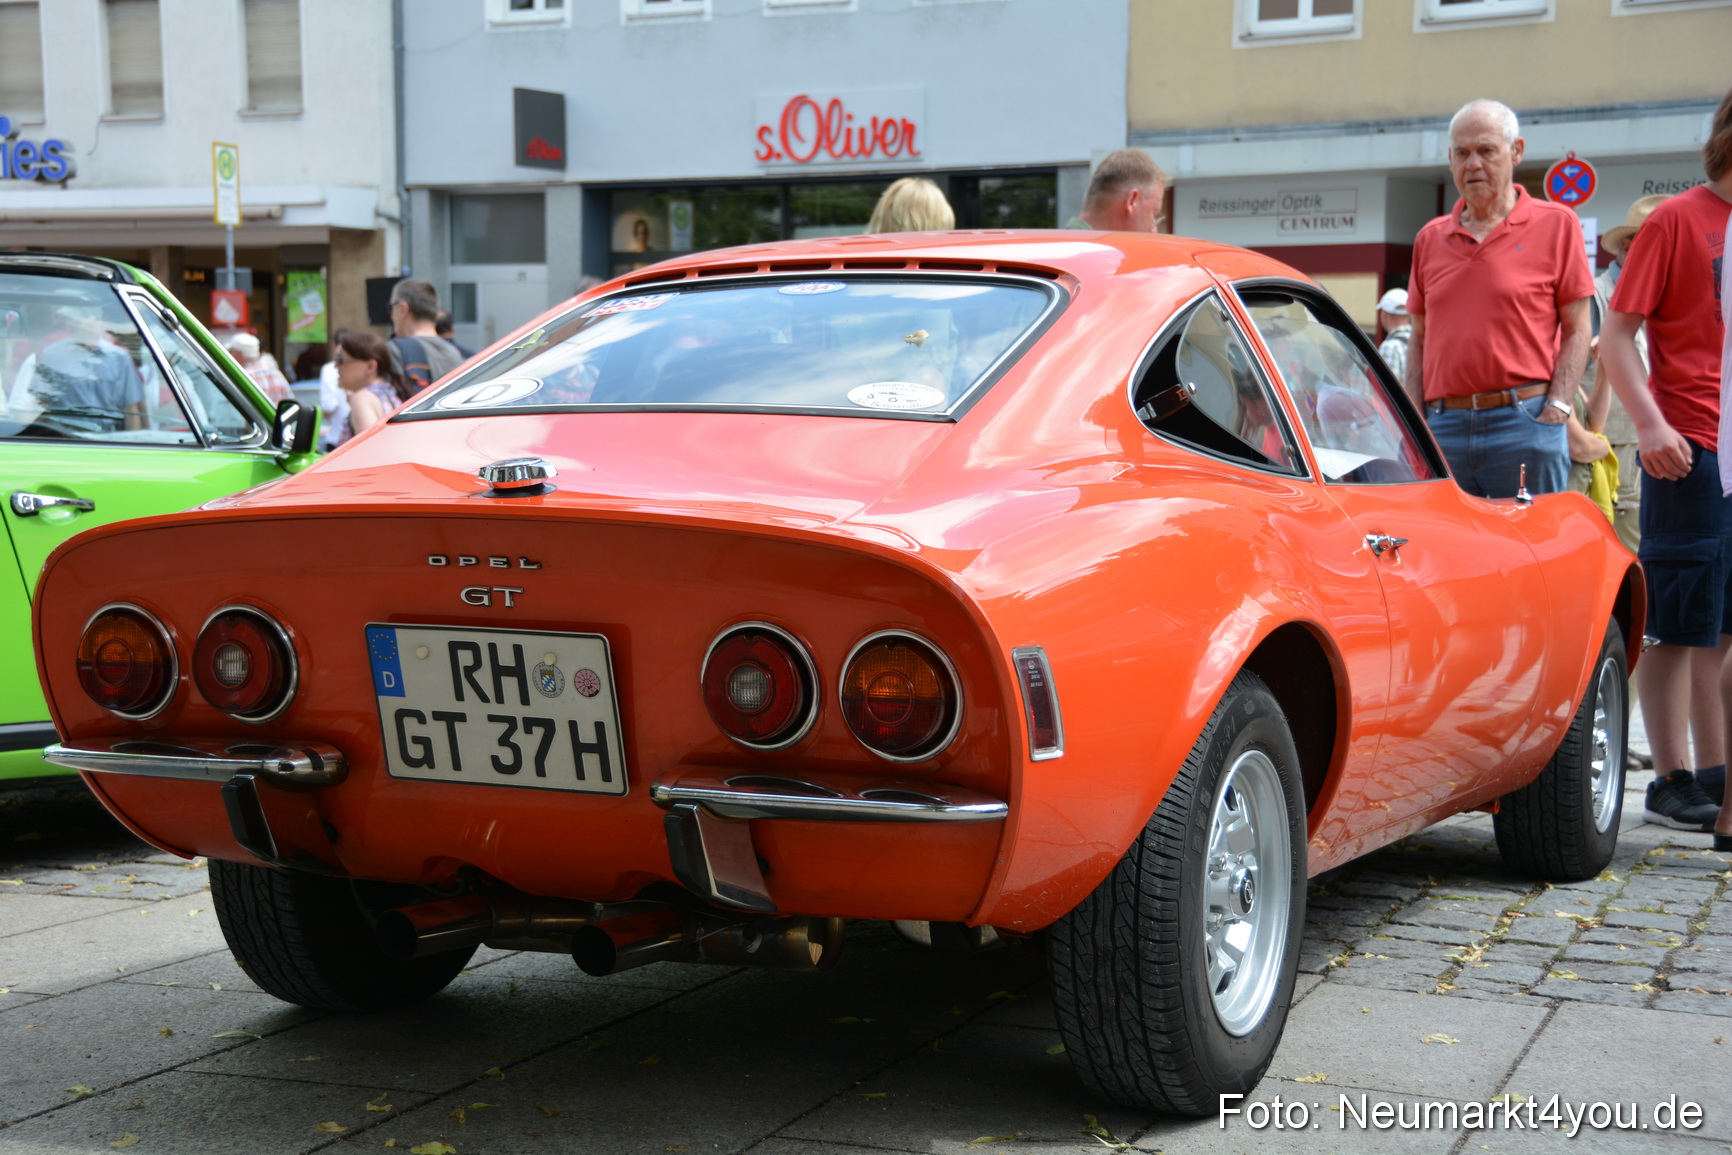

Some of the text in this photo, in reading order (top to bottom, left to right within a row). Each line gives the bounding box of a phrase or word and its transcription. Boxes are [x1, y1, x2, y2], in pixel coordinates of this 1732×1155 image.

[755, 94, 921, 163] s.Oliver
[1642, 177, 1707, 195] Reissi
[1199, 193, 1324, 215] Reissinger Optik
[1279, 216, 1355, 231] CENTRUM
[461, 383, 512, 405] D
[428, 555, 542, 570] OPEL
[460, 585, 525, 608] GT
[382, 671, 395, 688] D
[448, 640, 530, 706] RH
[394, 708, 467, 772] GT
